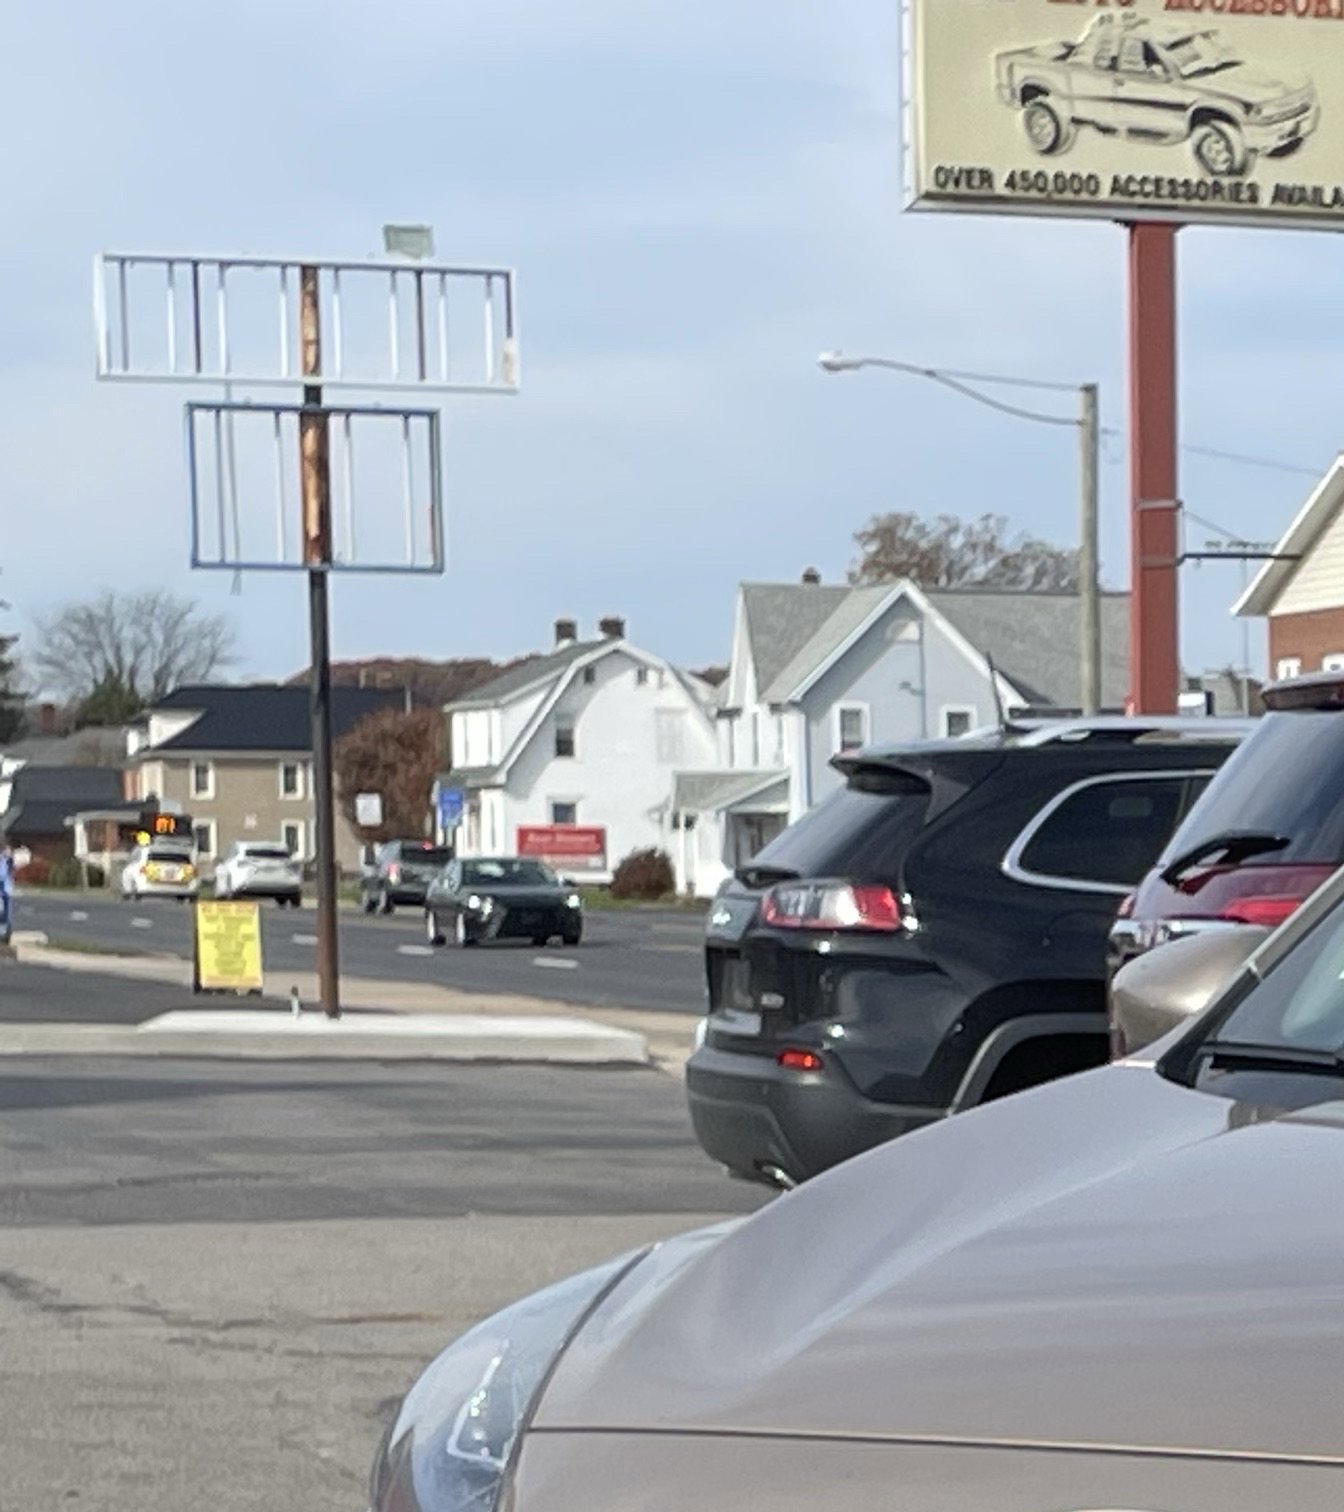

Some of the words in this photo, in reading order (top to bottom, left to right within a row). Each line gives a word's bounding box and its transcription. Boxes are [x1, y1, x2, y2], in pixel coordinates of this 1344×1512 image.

[934, 165, 994, 190] OVER
[1003, 170, 1100, 197] 450,000
[1109, 174, 1261, 204] ACCESSORIES
